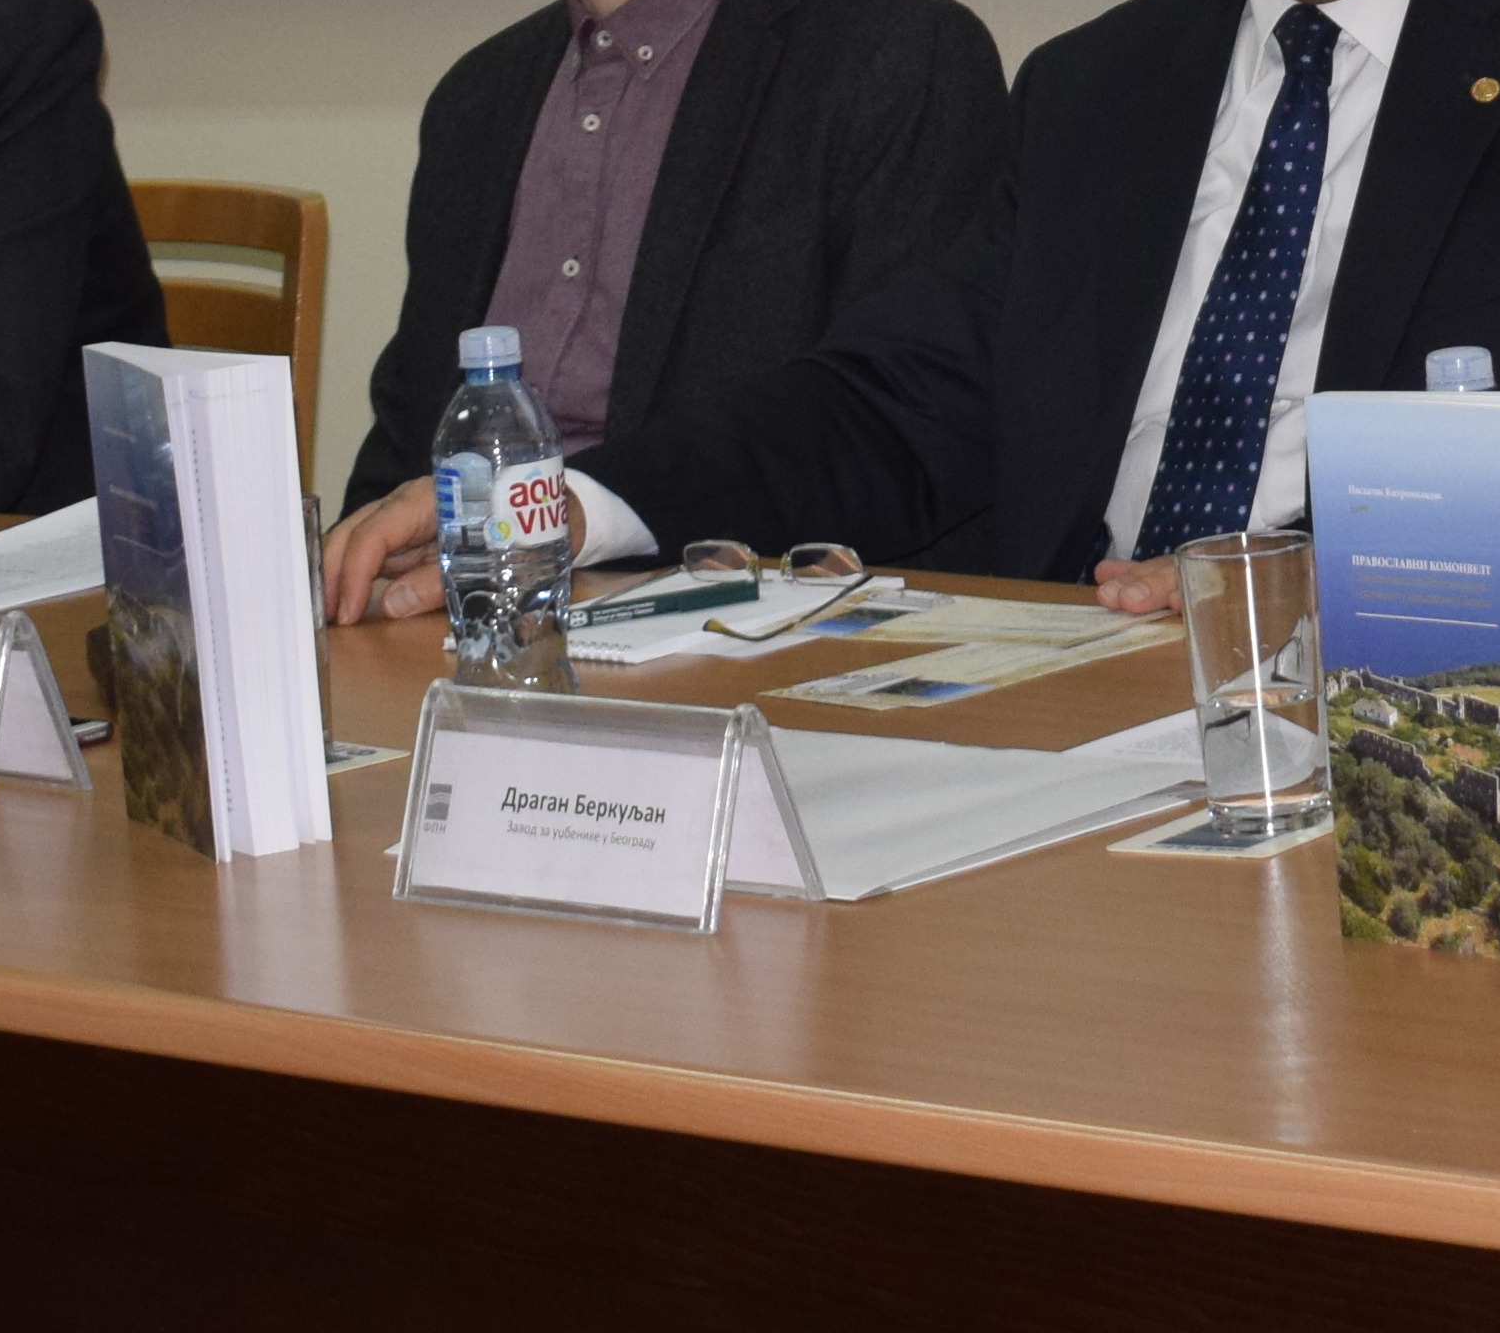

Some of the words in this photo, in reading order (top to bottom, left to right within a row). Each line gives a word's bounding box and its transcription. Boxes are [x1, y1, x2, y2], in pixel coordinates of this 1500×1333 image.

[1352, 554, 1428, 571] ПРАВОСЛАВНИ
[1429, 559, 1492, 576] КОМОНВЕЛТ
[500, 786, 569, 816] Драган
[574, 793, 666, 825] Беркуљан
[506, 819, 538, 837] Завод
[539, 825, 551, 837] за
[551, 825, 600, 844] уџбенике
[610, 831, 657, 851] Београду
